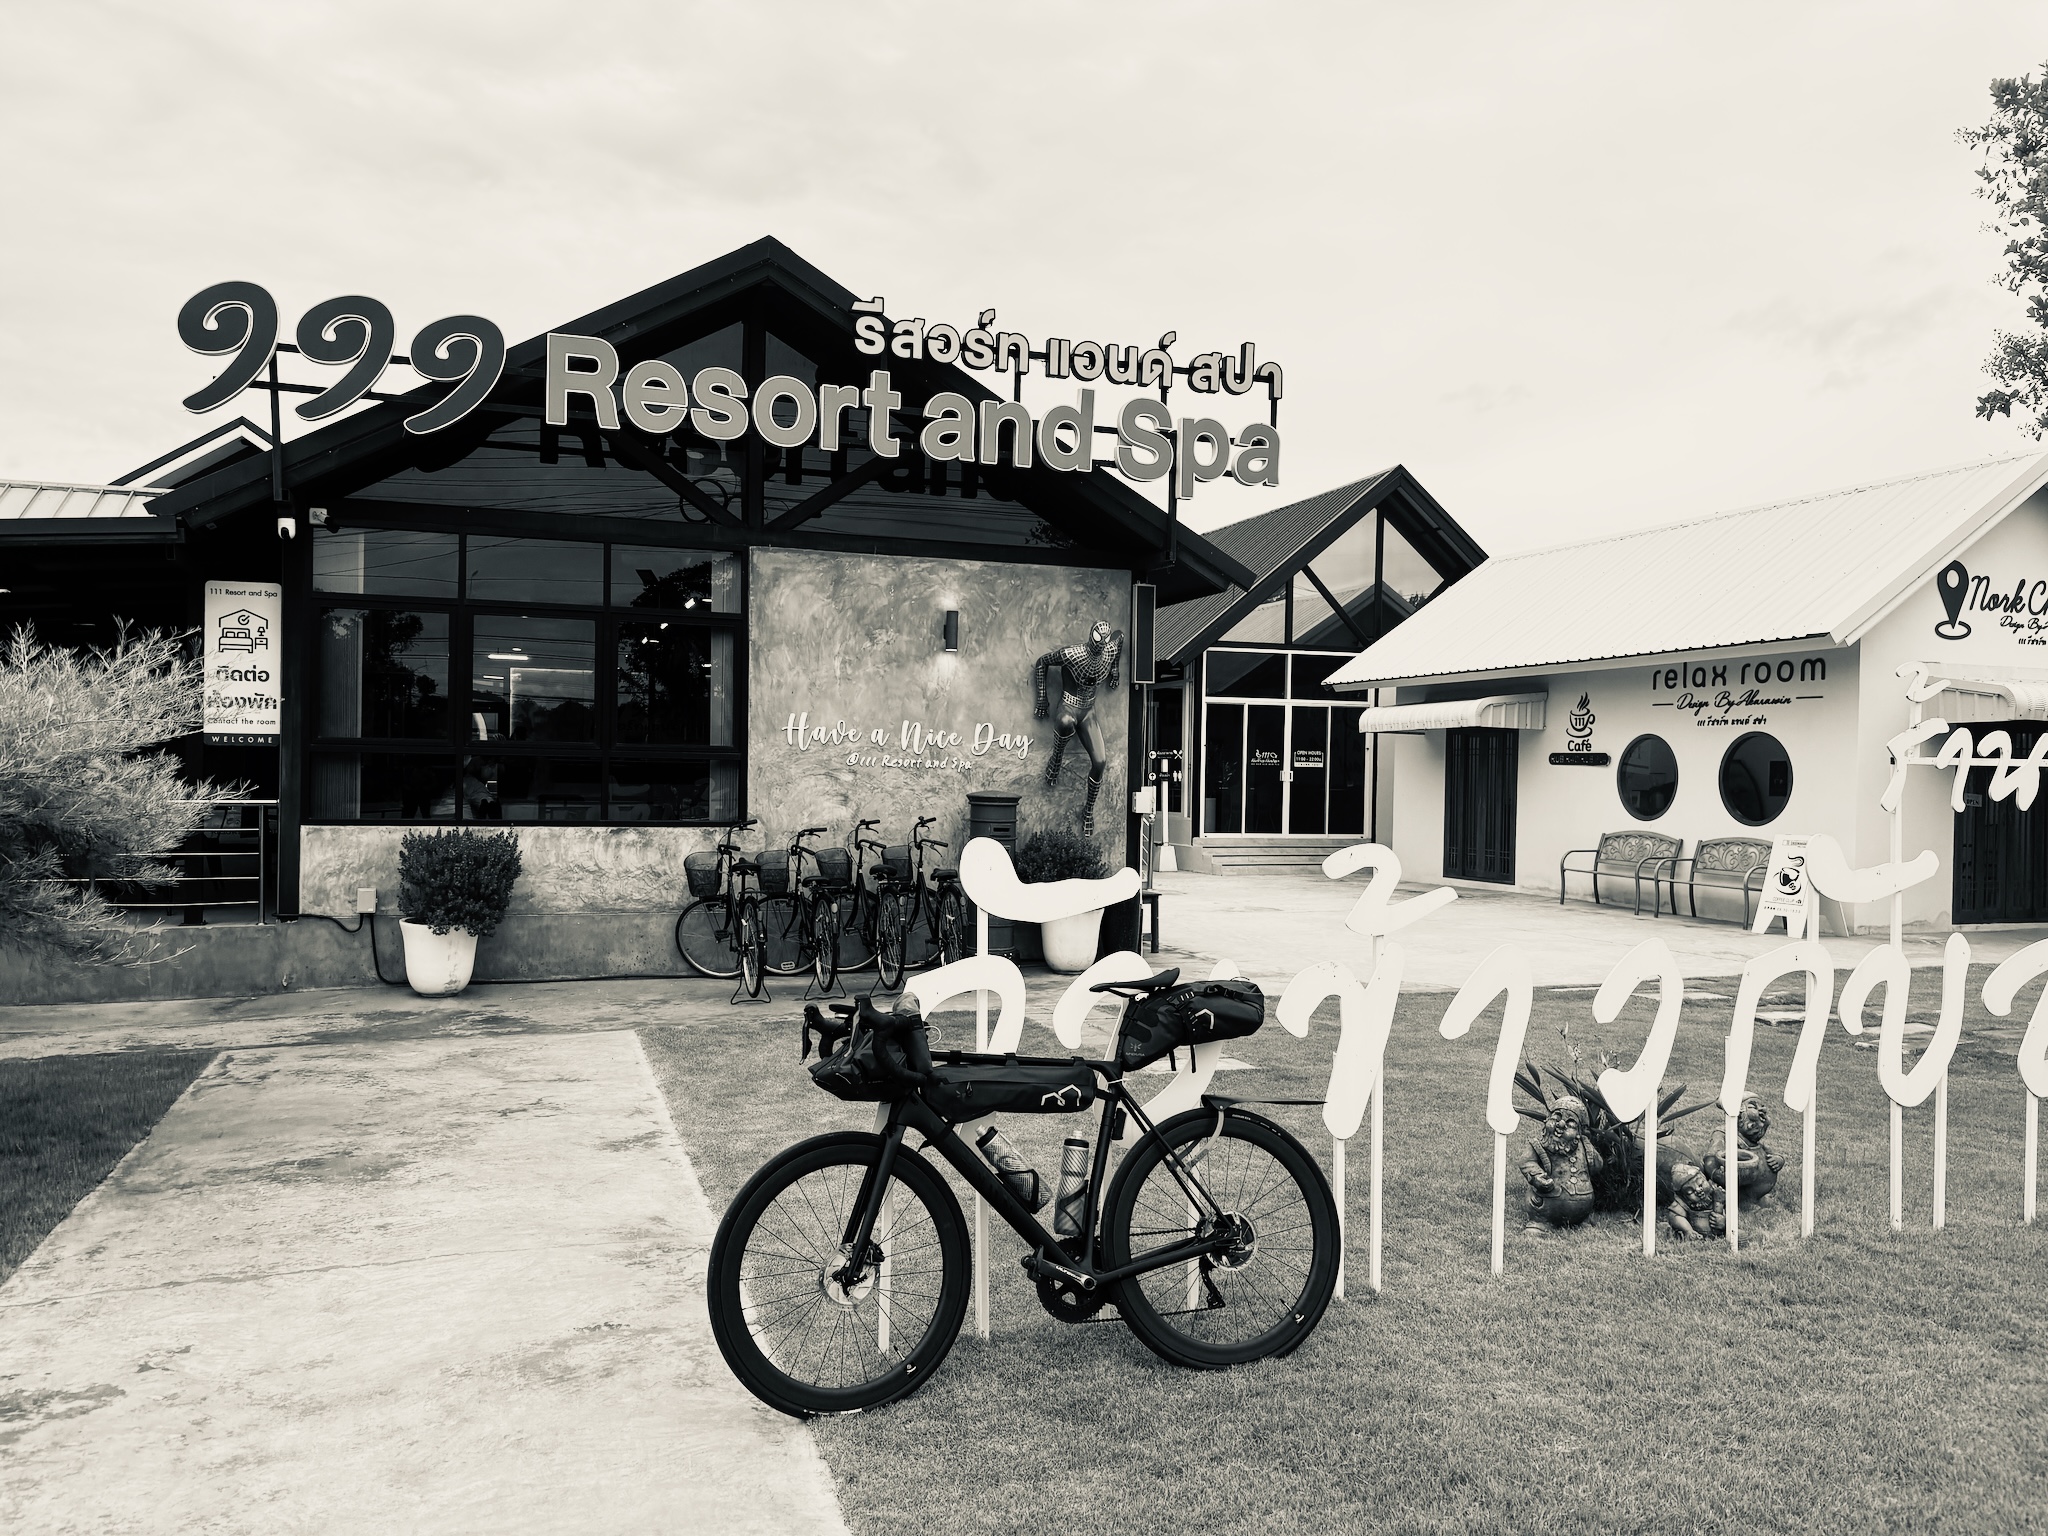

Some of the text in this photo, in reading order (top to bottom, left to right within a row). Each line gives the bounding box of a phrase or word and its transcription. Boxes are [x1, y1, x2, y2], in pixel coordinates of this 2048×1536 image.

[851, 297, 1283, 400] รีสอร์ท แอนด์ สปา
[546, 332, 901, 458] Resort
[920, 388, 1096, 473] and
[1114, 398, 1281, 500] Spa
[225, 588, 247, 596] Resort
[264, 590, 278, 599] Spa
[1969, 575, 2026, 613] Nork
[1652, 657, 1827, 691] relax room
[1714, 690, 1735, 714] By
[241, 717, 254, 725] the
[211, 735, 273, 744] WELCOME
[782, 711, 1035, 760] Have a Nice Day
[1567, 738, 1592, 752] Café
[881, 755, 923, 768] Resort
[925, 757, 949, 769] and
[951, 756, 973, 772] Spa
